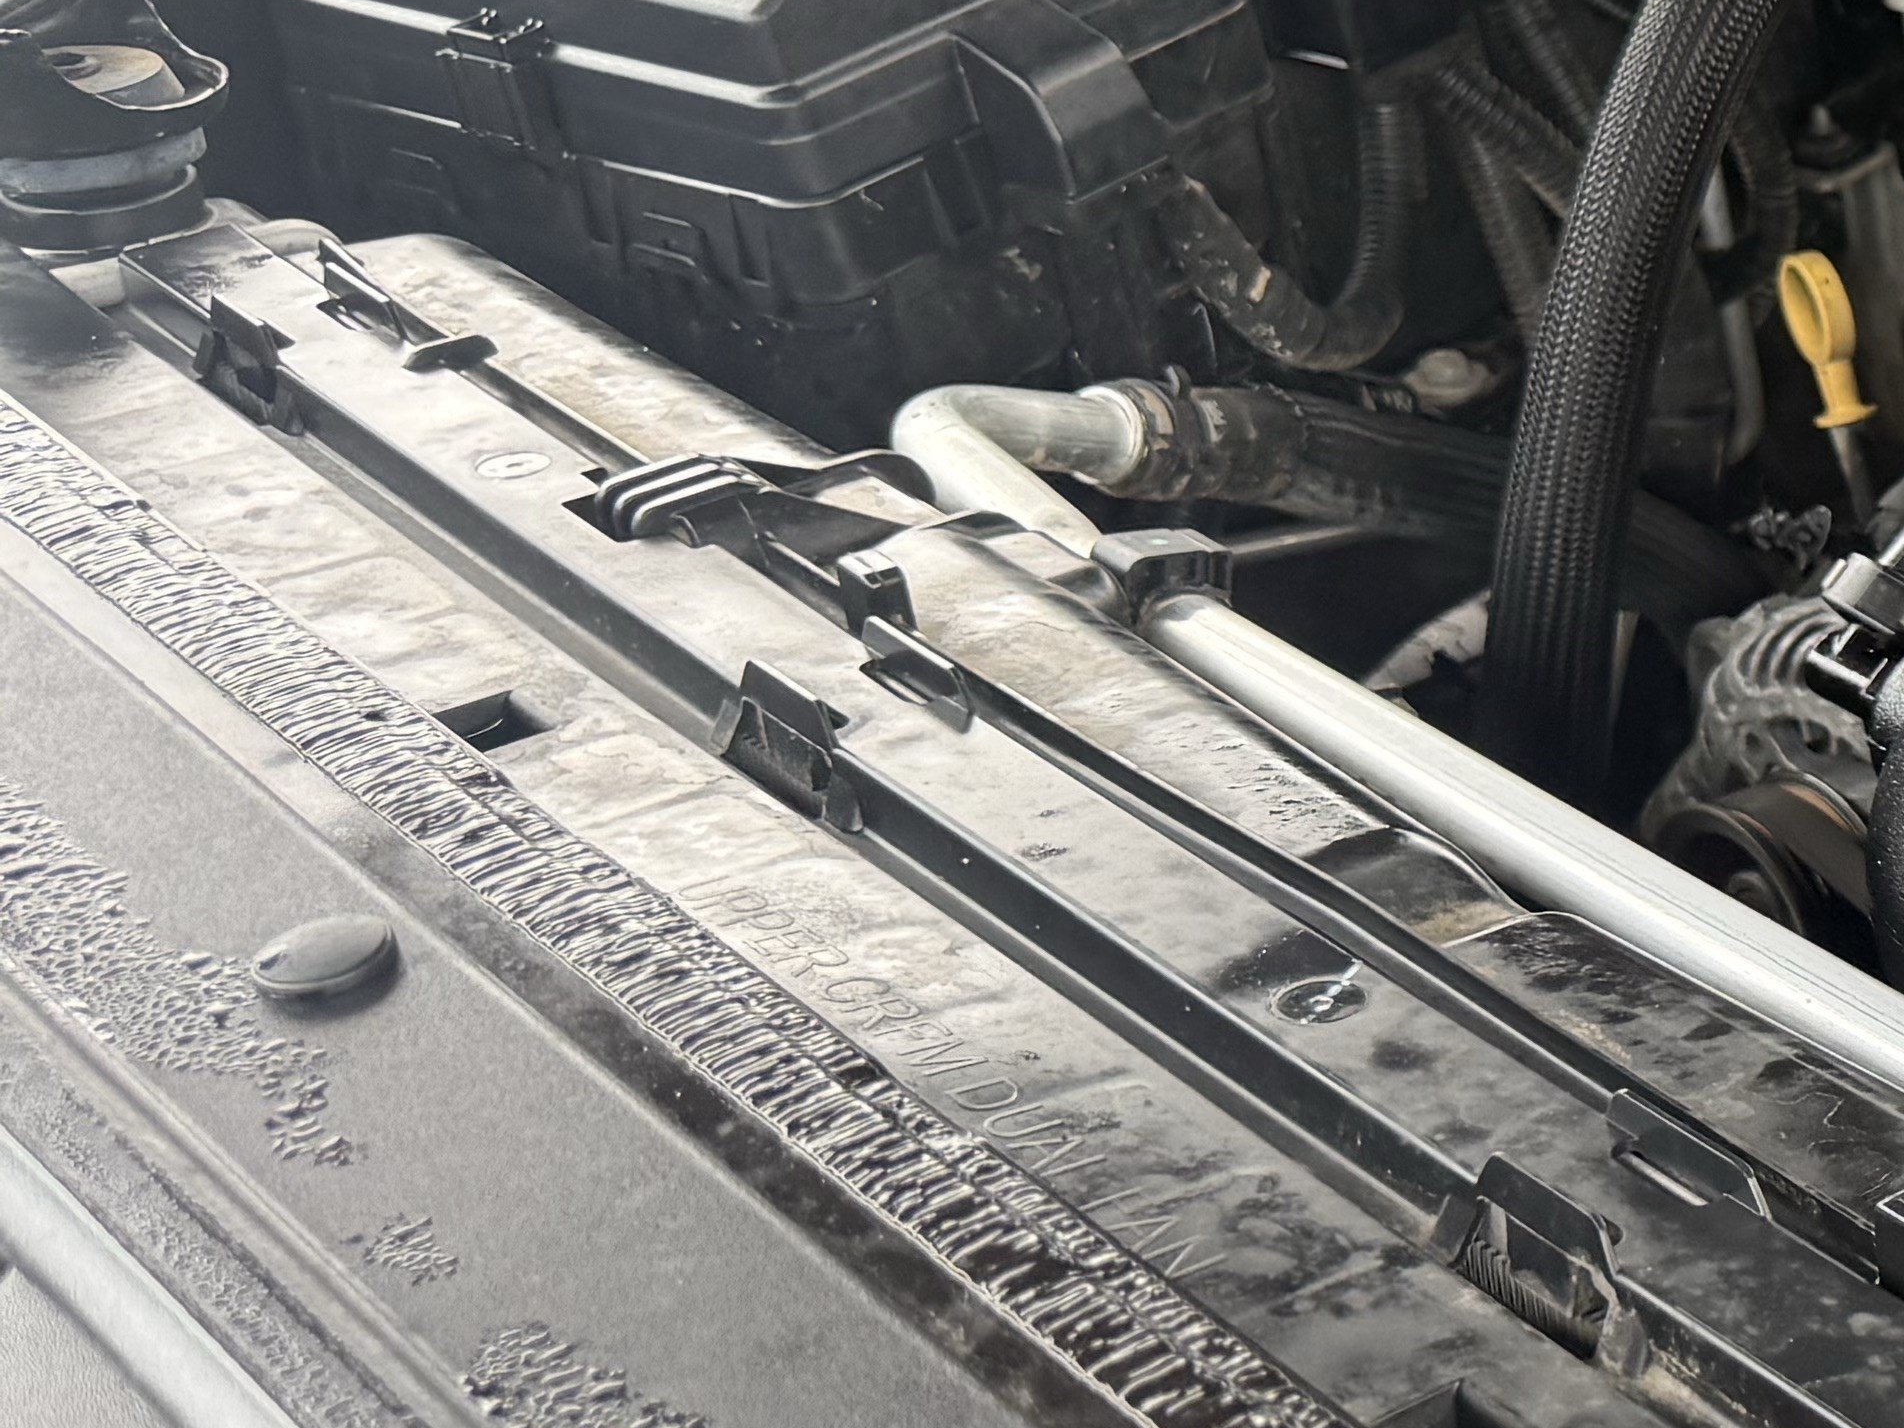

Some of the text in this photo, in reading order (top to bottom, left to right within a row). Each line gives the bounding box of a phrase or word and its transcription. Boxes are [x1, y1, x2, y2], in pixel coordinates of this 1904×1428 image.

[678, 875, 850, 979] UPPER
[945, 1076, 1108, 1178] DUAL
[1075, 1186, 1230, 1277] FAN
